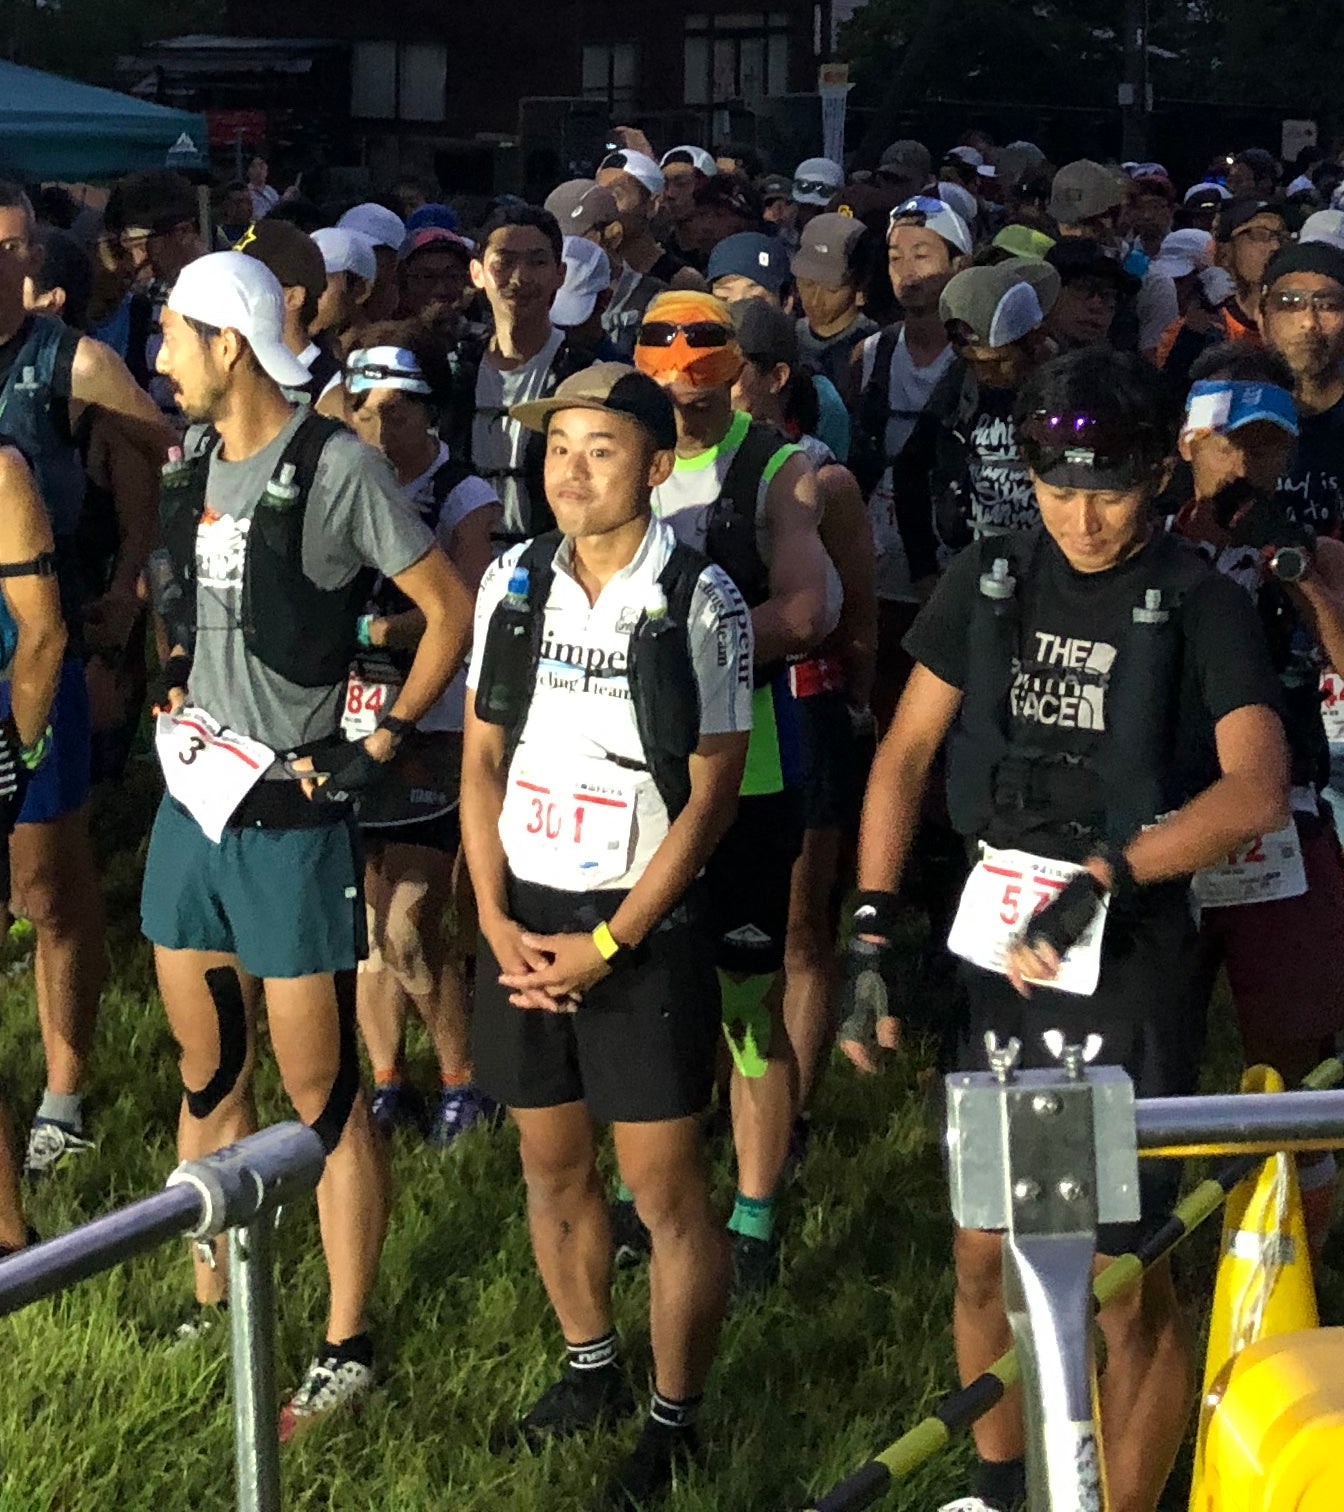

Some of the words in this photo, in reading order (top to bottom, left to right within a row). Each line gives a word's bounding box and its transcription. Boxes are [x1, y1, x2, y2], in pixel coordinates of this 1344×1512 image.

[541, 630, 626, 692] impe
[1035, 631, 1092, 668] THE
[1010, 688, 1077, 727] FACE
[526, 797, 585, 844] 301
